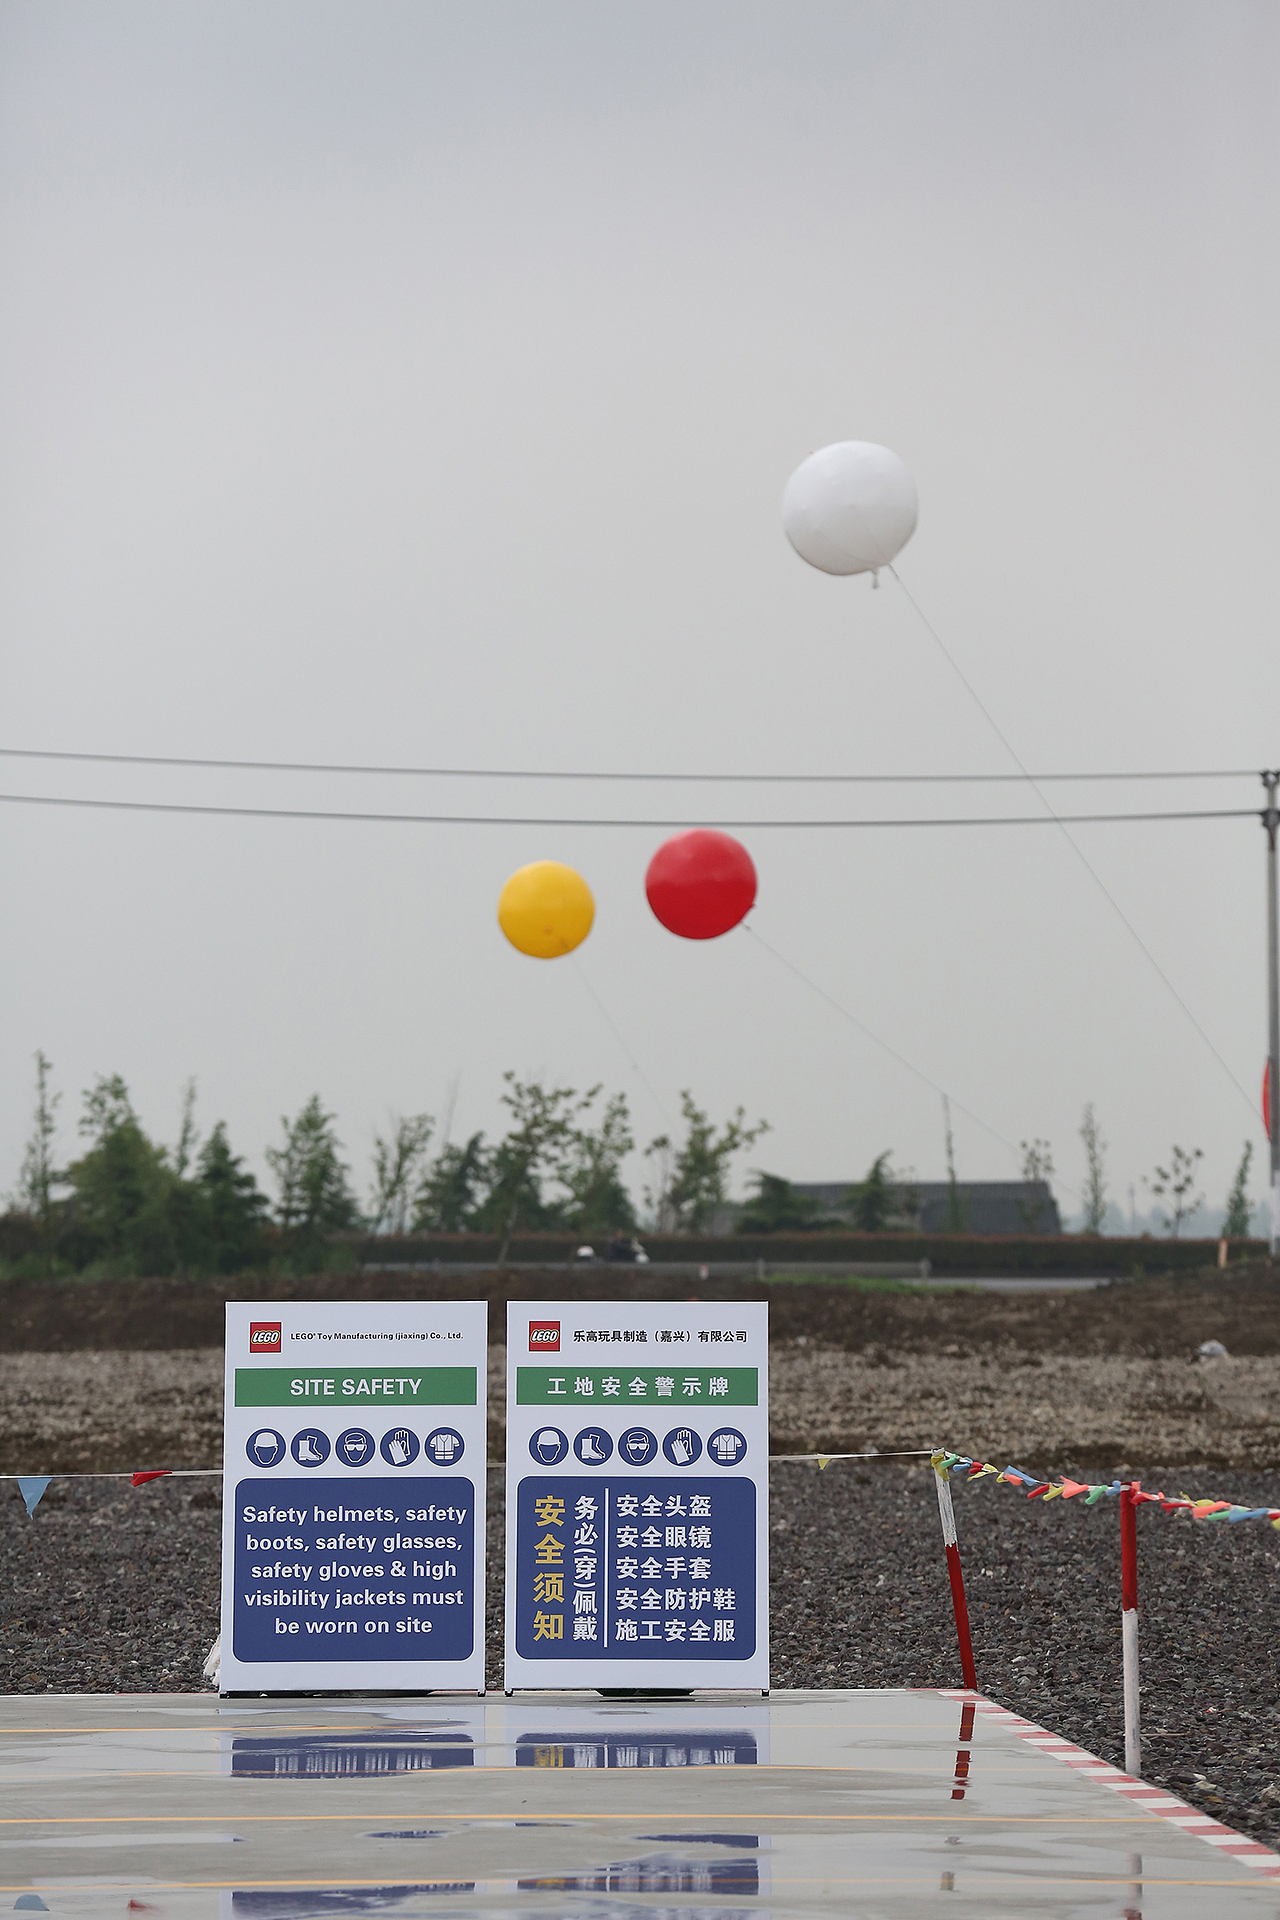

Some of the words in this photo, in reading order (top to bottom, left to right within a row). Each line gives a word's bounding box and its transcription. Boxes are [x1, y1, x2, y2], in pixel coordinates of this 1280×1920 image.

[252, 1330, 280, 1344] LEGO
[317, 1333, 332, 1341] Toy
[334, 1333, 393, 1341] Manufacturing
[396, 1332, 428, 1340] (jiaxing)
[531, 1329, 558, 1342] LEGO
[290, 1379, 335, 1395] SITE
[342, 1378, 423, 1395] SAFETY
[547, 1376, 729, 1397] 工地安全警示牌
[243, 1505, 307, 1526] Safety
[314, 1505, 400, 1523] helmets,
[406, 1505, 467, 1524] safety
[616, 1495, 712, 1517] 安全头盔
[246, 1534, 309, 1552] boots,
[316, 1534, 377, 1552] safety
[383, 1533, 463, 1552] glasses,
[616, 1525, 712, 1548] 安全眼镜
[251, 1562, 312, 1581] safety
[319, 1562, 385, 1581] gloves
[390, 1561, 407, 1577] &
[413, 1561, 456, 1580] high
[533, 1495, 566, 1641] 安全须知
[616, 1556, 712, 1580] 安全手套
[244, 1590, 329, 1609] visibility
[334, 1589, 406, 1609] jackets
[412, 1590, 464, 1605] must
[616, 1588, 736, 1611] 安全防护鞋
[275, 1618, 300, 1634] be
[305, 1619, 358, 1634] worn
[364, 1619, 389, 1633] on
[396, 1617, 433, 1633] site
[615, 1619, 736, 1642] 施工安全服
